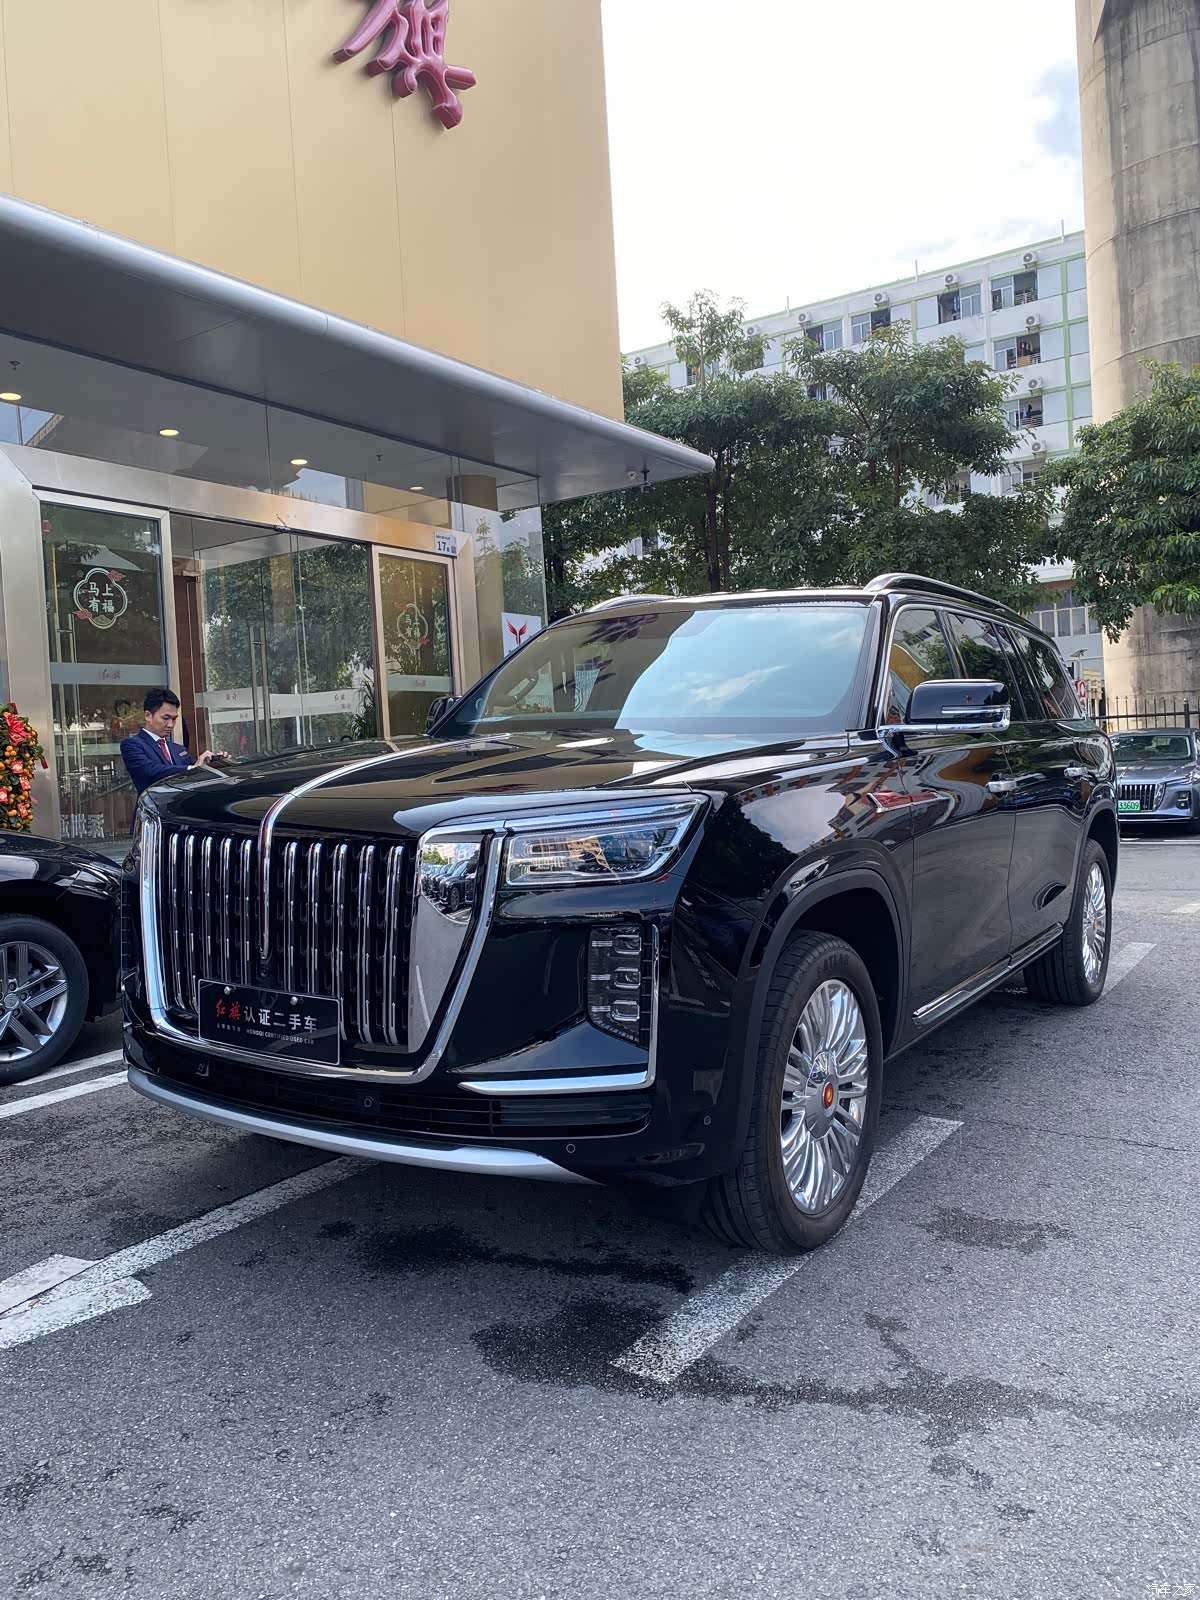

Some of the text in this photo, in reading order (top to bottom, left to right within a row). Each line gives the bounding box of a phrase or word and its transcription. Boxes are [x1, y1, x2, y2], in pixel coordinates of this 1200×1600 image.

[88, 582, 114, 597] 马上
[88, 597, 115, 613] 有福
[246, 1028, 264, 1037] HONGQI
[264, 1031, 289, 1041] CERTIFIED
